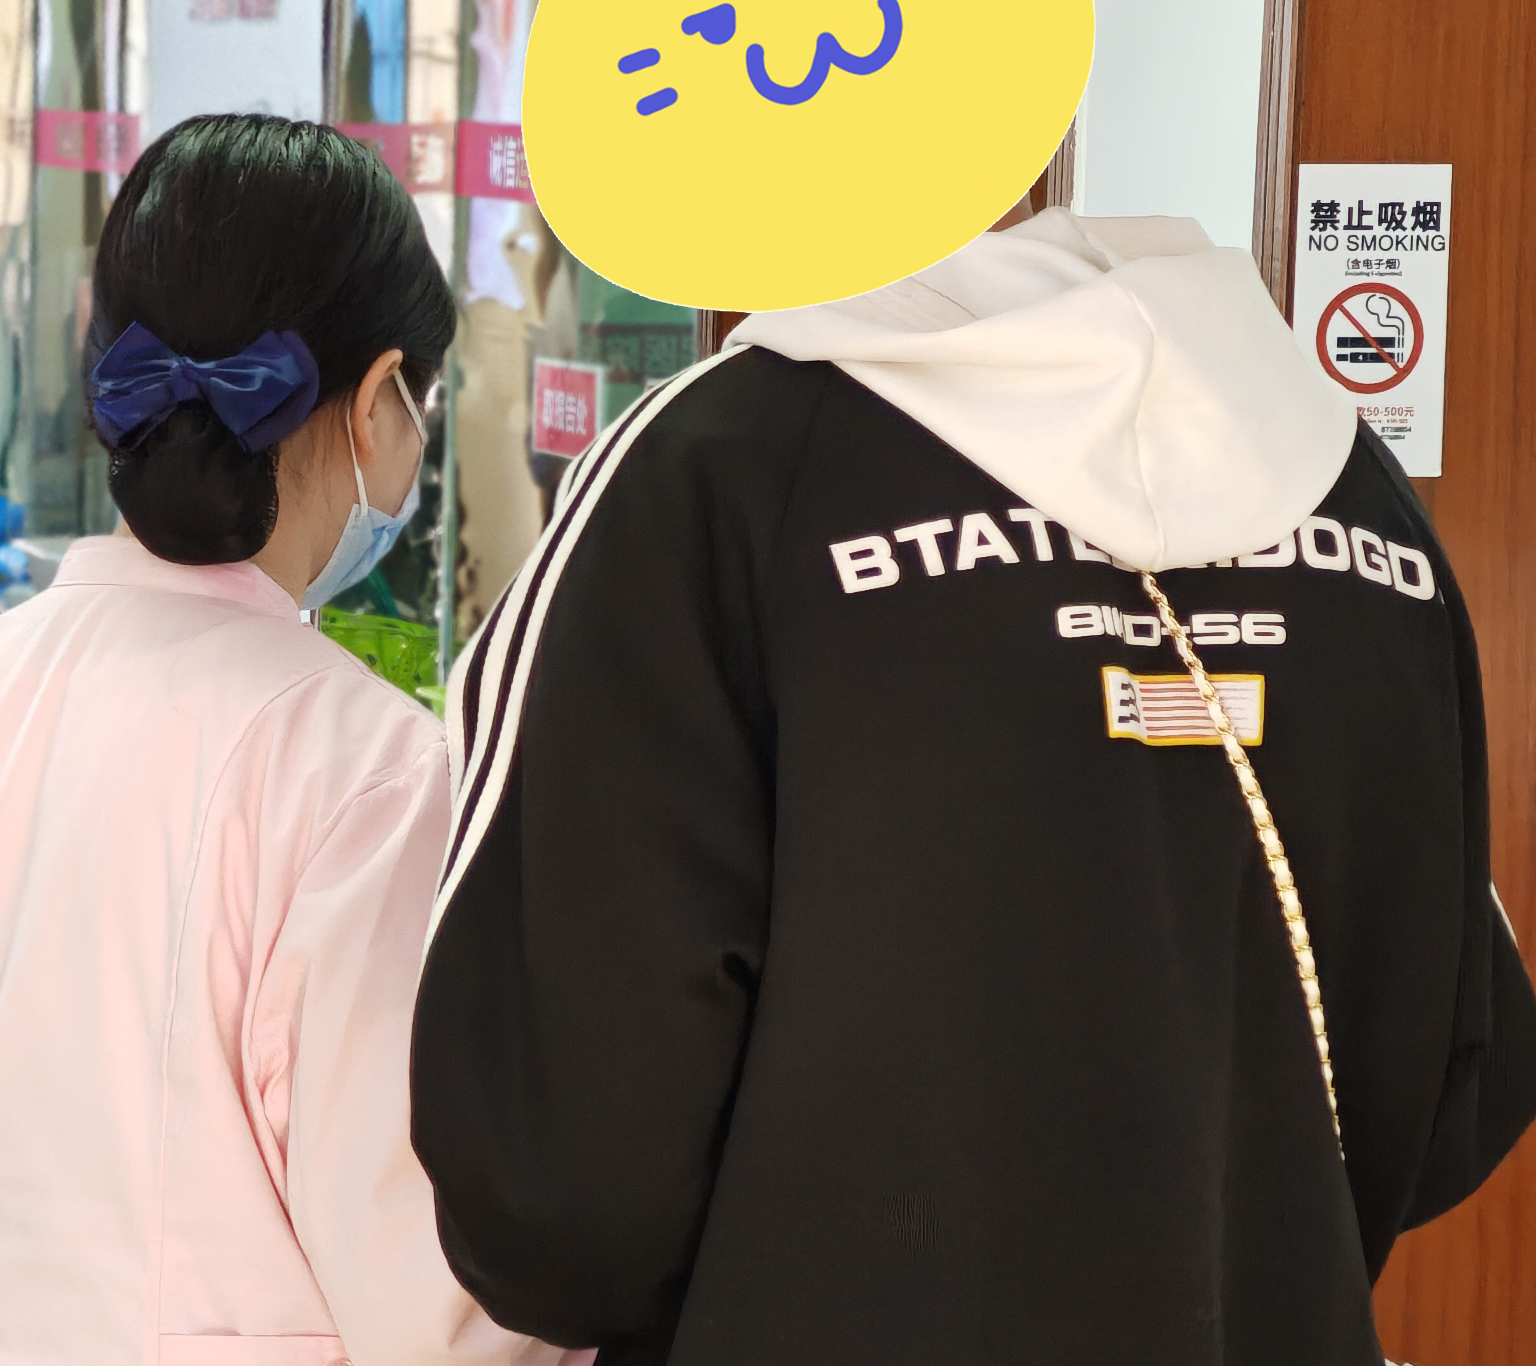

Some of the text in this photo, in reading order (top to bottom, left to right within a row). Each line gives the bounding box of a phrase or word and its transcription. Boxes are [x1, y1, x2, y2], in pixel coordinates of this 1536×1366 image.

[1310, 200, 1442, 232] 禁止吸烟
[1308, 234, 1446, 252] NO SMOKING
